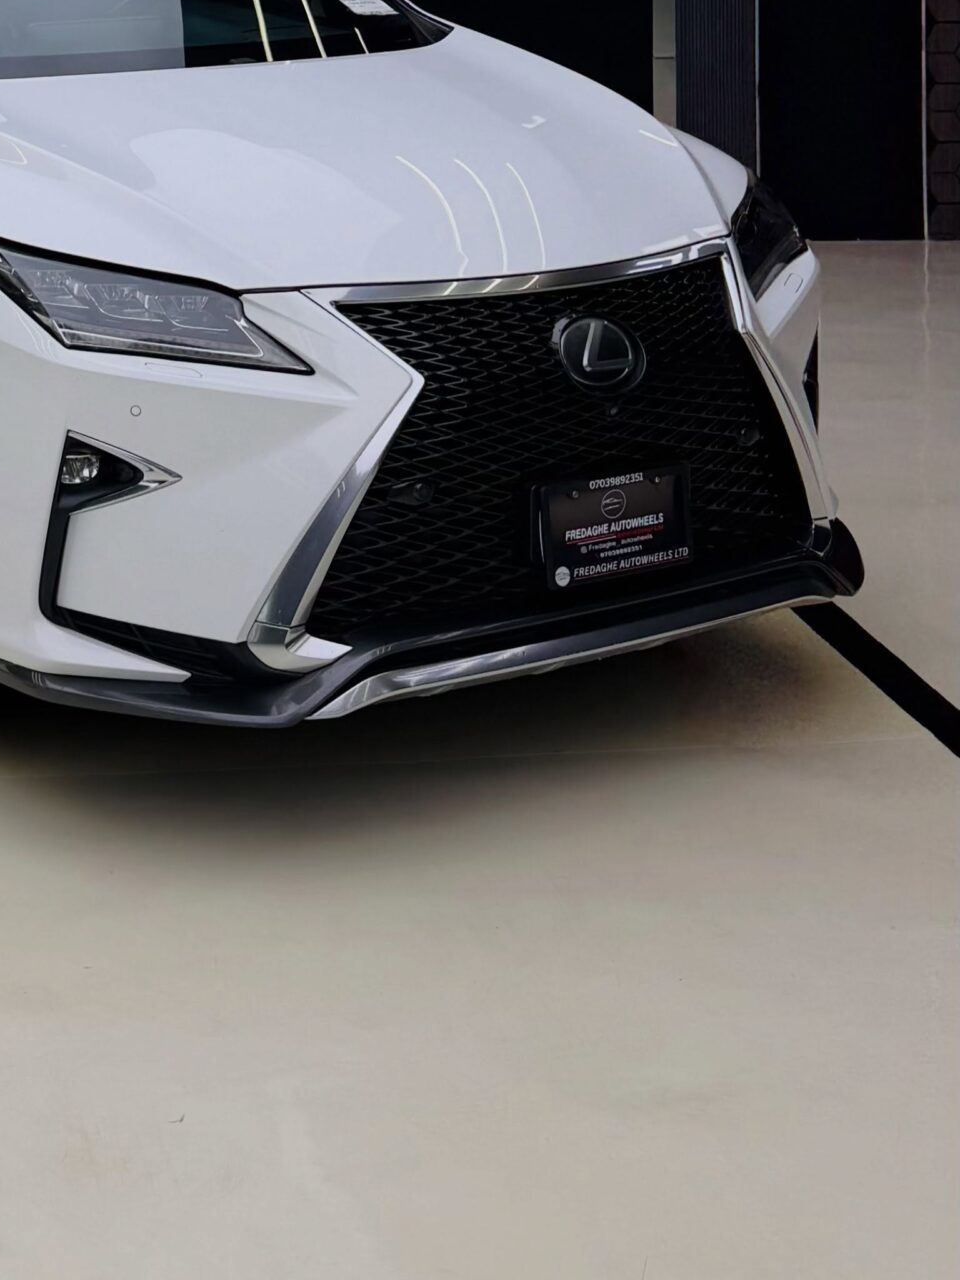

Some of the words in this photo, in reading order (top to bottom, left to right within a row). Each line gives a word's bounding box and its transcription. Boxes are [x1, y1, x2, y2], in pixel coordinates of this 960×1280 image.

[589, 472, 644, 490] 07039892351
[565, 523, 609, 541] FREDAGHE
[610, 512, 664, 532] AUTOWHEELS
[573, 560, 618, 578] FREDAGHE
[619, 549, 673, 569] AUTOWHEELS
[674, 546, 689, 558] LTD
